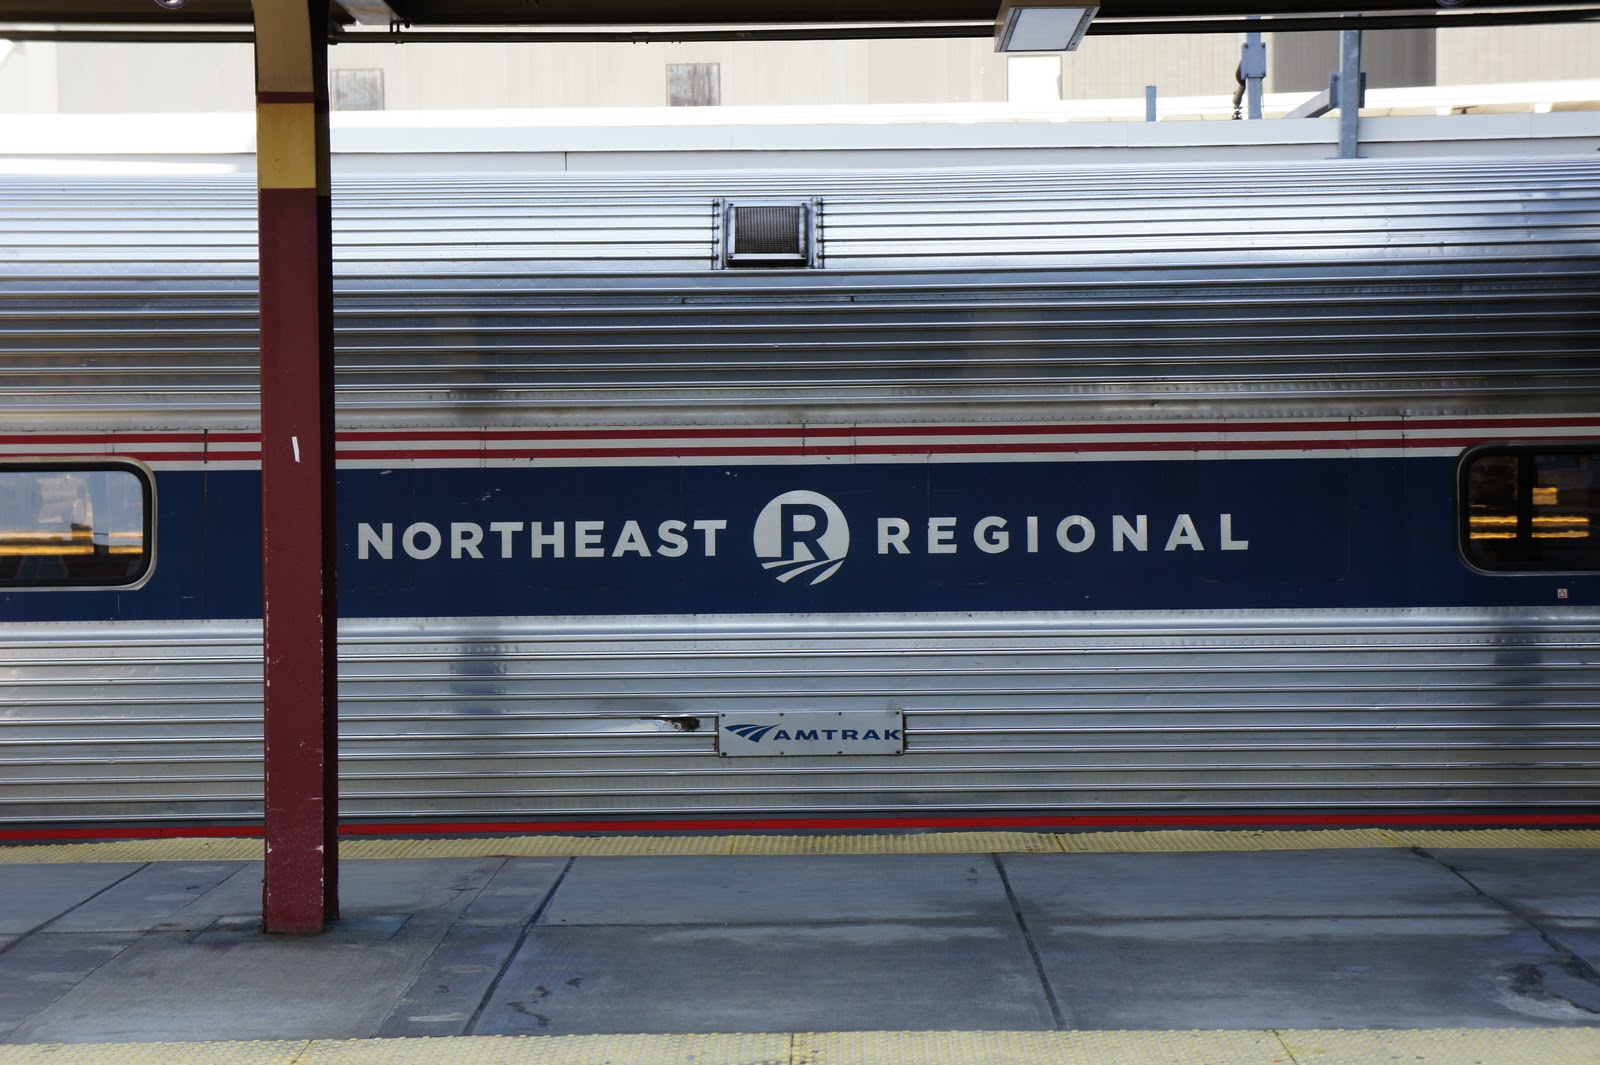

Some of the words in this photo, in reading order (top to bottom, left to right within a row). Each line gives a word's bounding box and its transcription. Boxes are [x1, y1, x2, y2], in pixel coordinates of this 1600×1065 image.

[357, 519, 727, 561] NORTHEAST
[780, 503, 831, 560] R
[877, 513, 1249, 555] REGIONAL
[773, 729, 902, 741] AMTRAK
